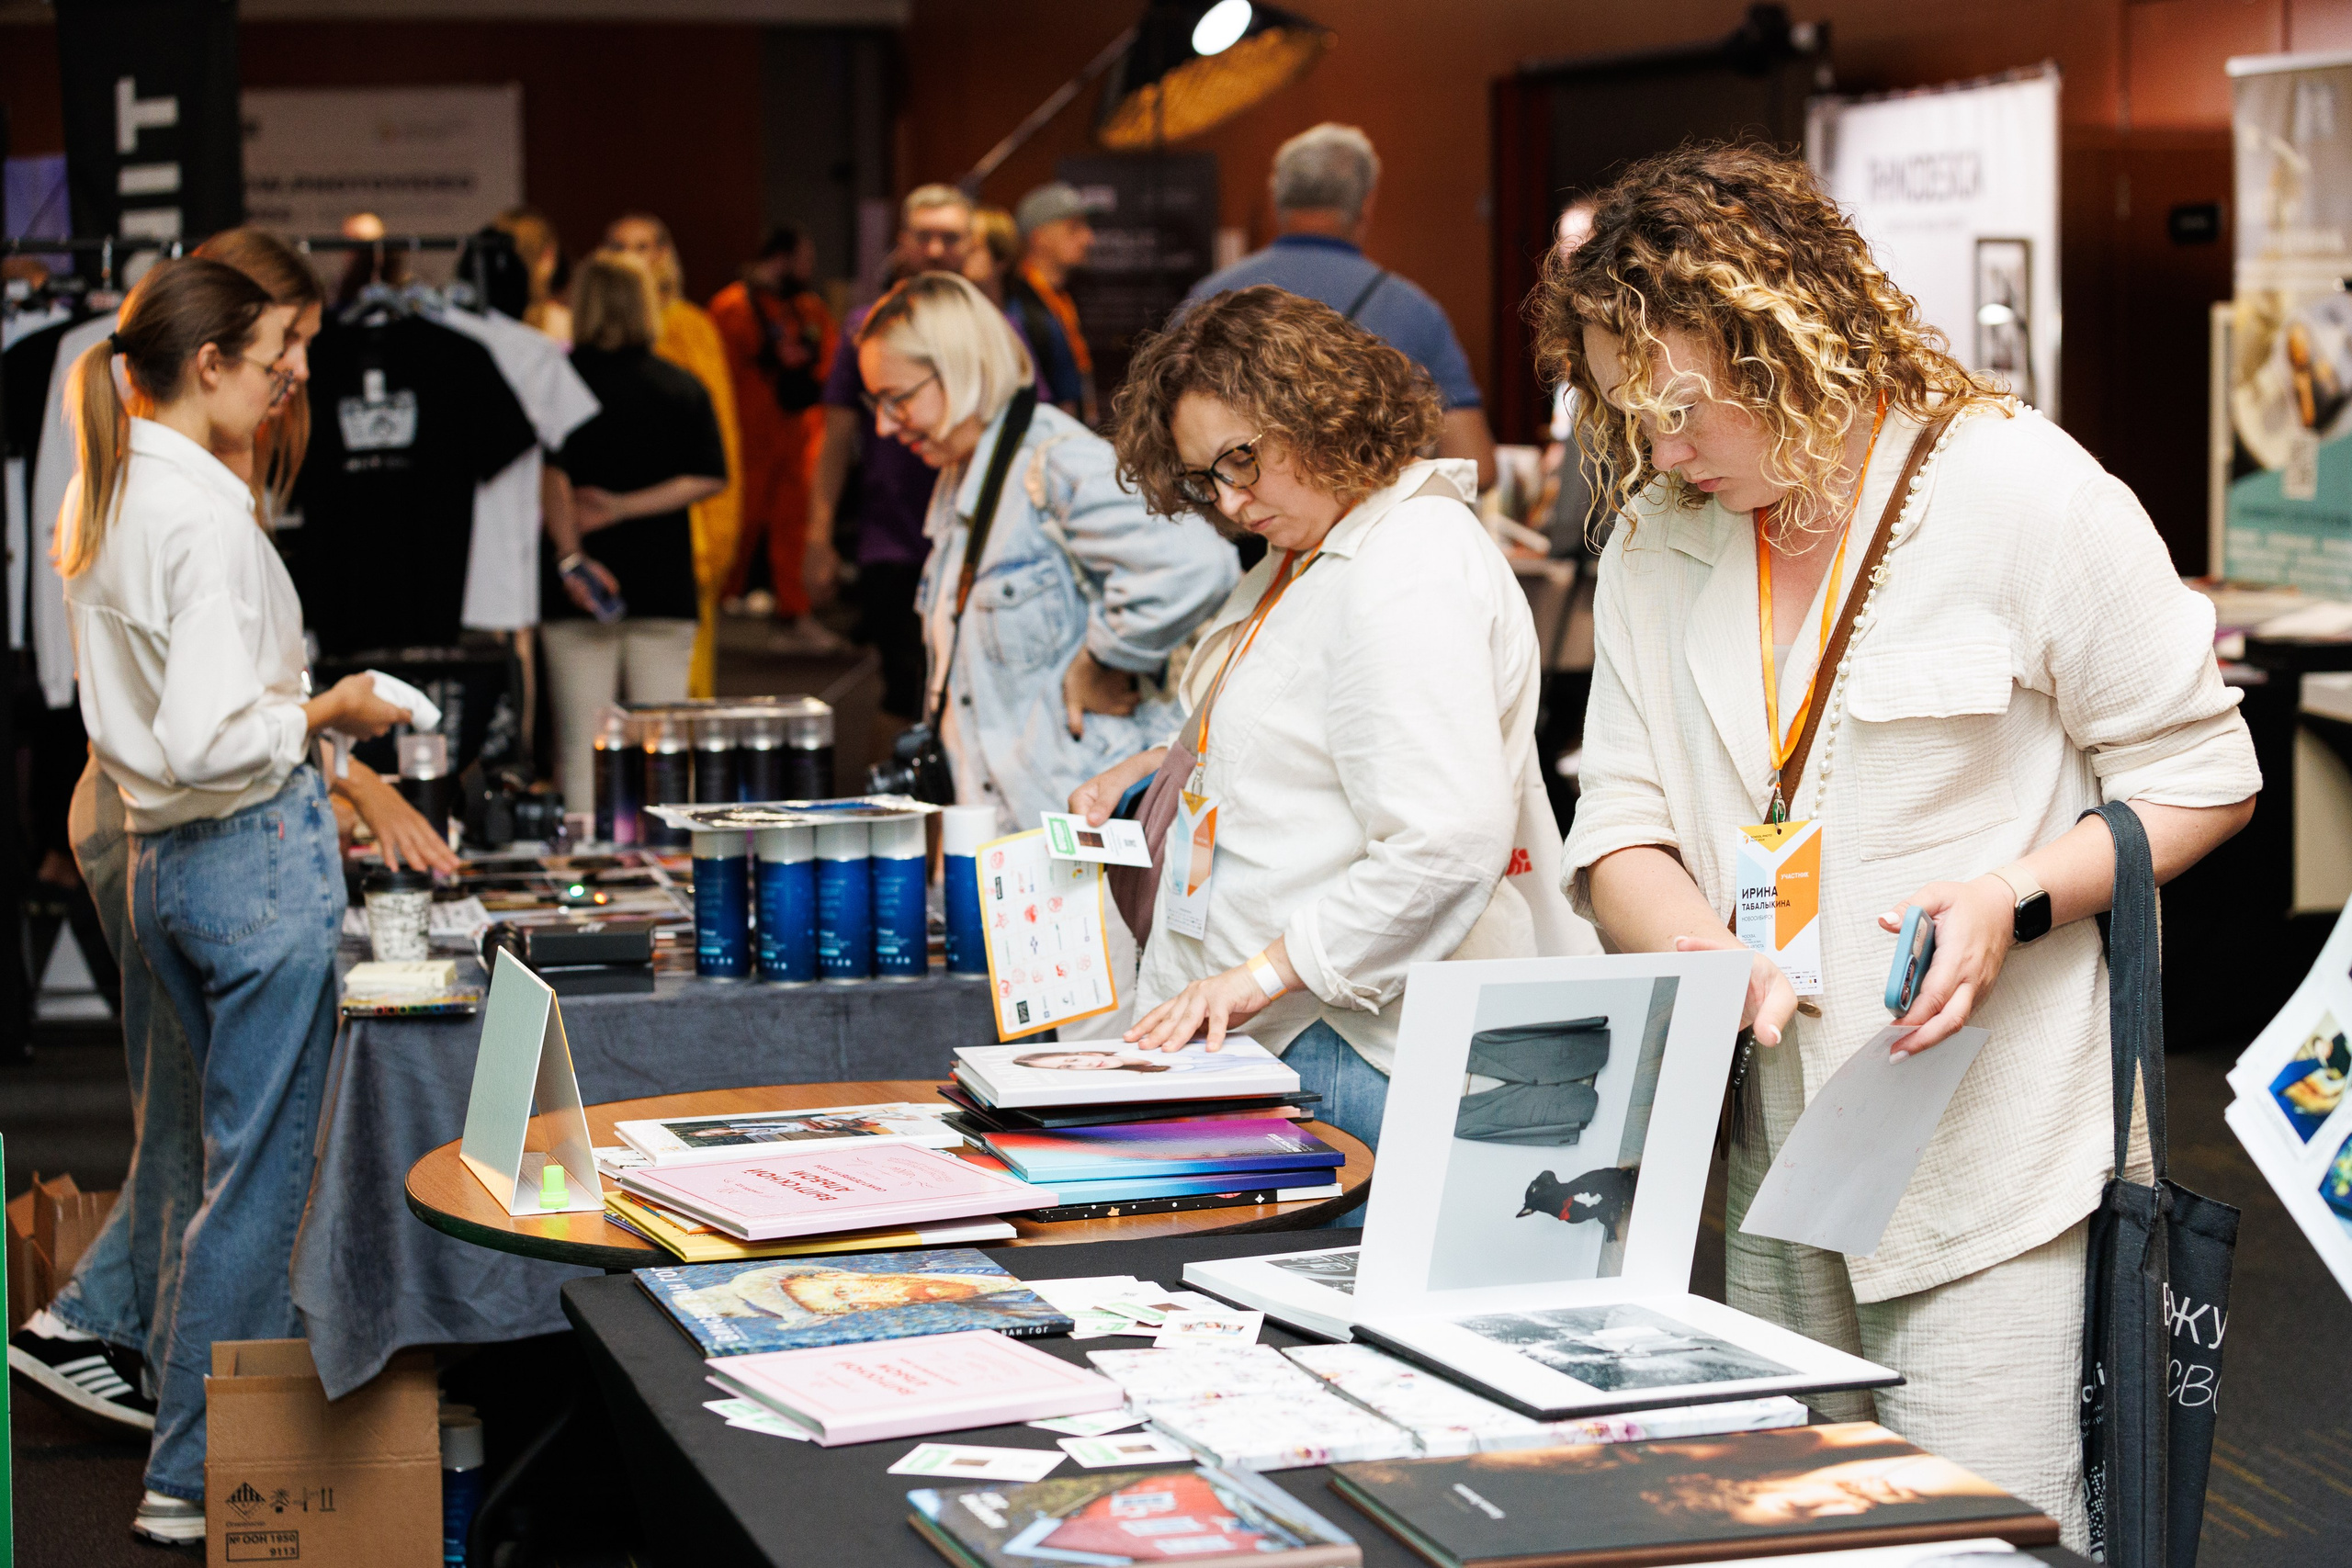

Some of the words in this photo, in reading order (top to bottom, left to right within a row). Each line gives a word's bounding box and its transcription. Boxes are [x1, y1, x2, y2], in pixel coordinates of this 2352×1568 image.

[1742, 886, 1779, 899] ИРИНА
[1742, 899, 1791, 911] ТАБАЛЫКИНА
[1742, 914, 1773, 922] НОВОСИБИРСК
[742, 1168, 838, 1201] ВЫПУСКНОЙ
[788, 1169, 854, 1193] АЛЬБОМ
[650, 1267, 683, 1282] ГОГ
[1001, 1327, 1023, 1337] ВАН
[1029, 1325, 1049, 1335] ГОГ
[243, 1535, 267, 1544] ООН
[271, 1534, 296, 1543] 1950
[270, 1548, 296, 1556] 9113
